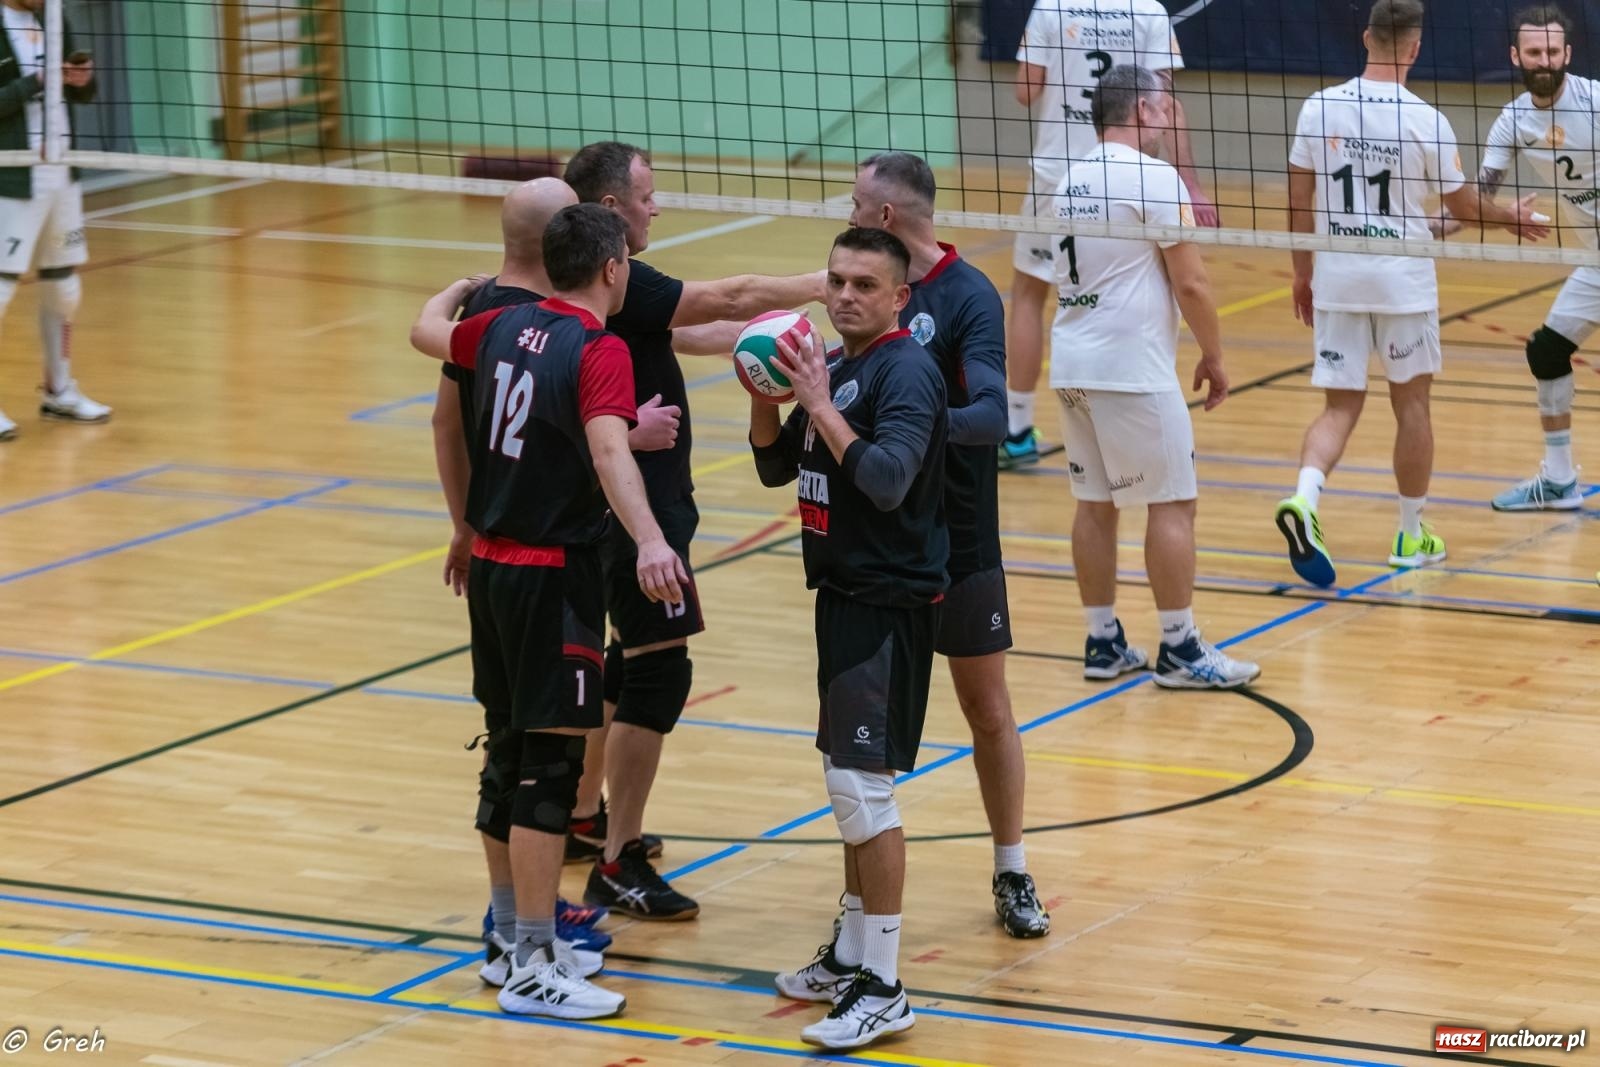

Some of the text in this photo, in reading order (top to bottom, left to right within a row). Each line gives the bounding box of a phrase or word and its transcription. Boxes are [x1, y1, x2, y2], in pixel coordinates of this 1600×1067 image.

[1332, 164, 1391, 215] 11
[1556, 155, 1582, 181] 2
[489, 361, 534, 460] 12
